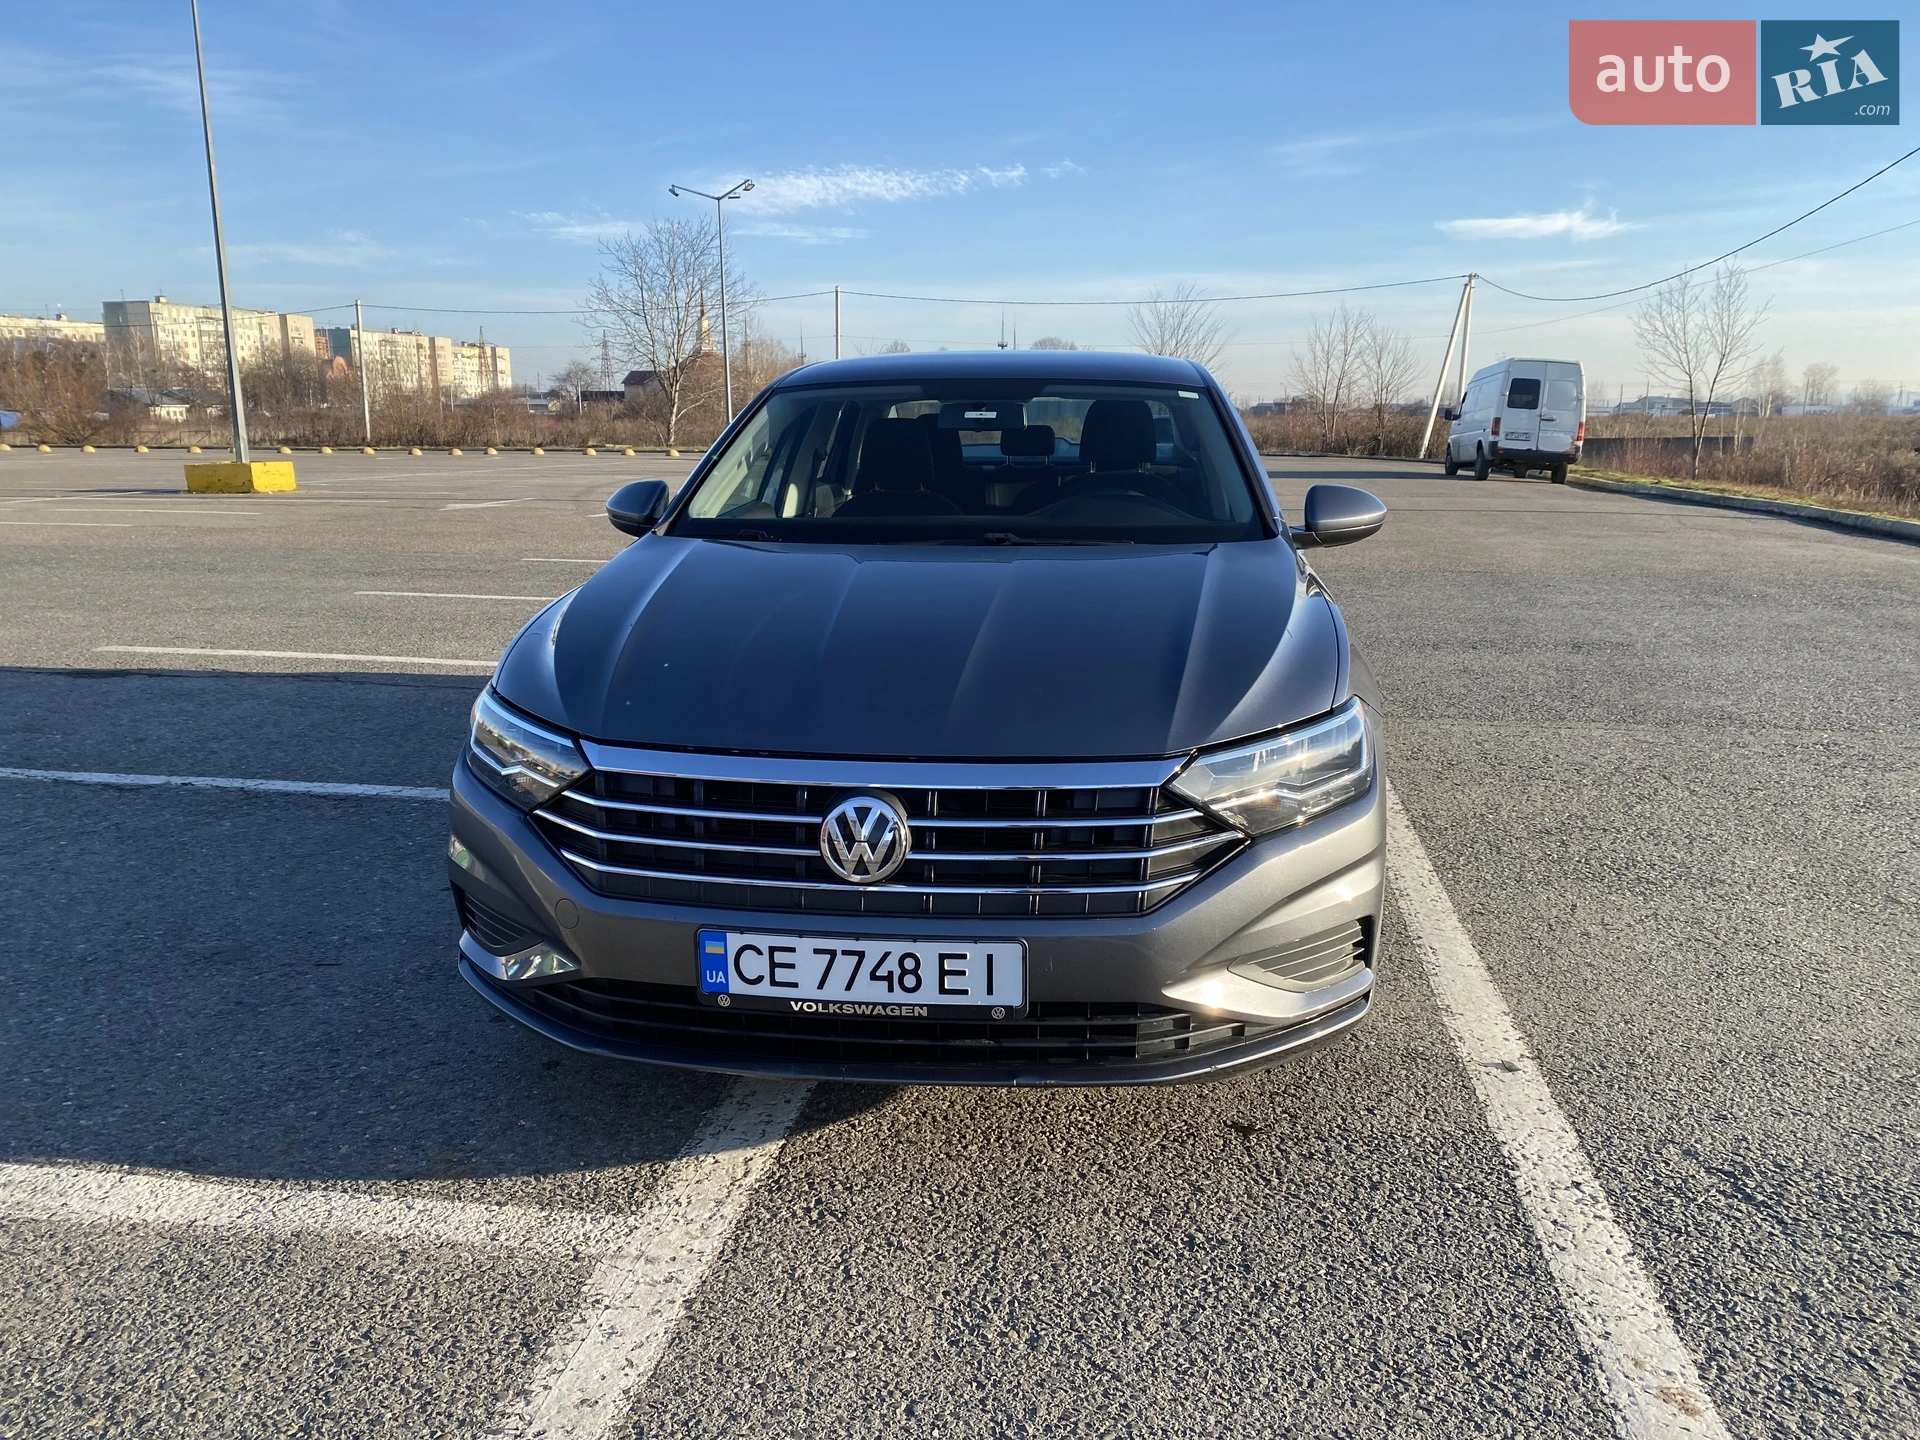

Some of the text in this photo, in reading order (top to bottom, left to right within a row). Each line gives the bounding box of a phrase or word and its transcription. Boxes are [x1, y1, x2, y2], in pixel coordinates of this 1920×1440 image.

[706, 970, 726, 984] UA
[733, 943, 994, 996] CE 7748 EI
[789, 1001, 928, 1017] VOLKSWAGEN
